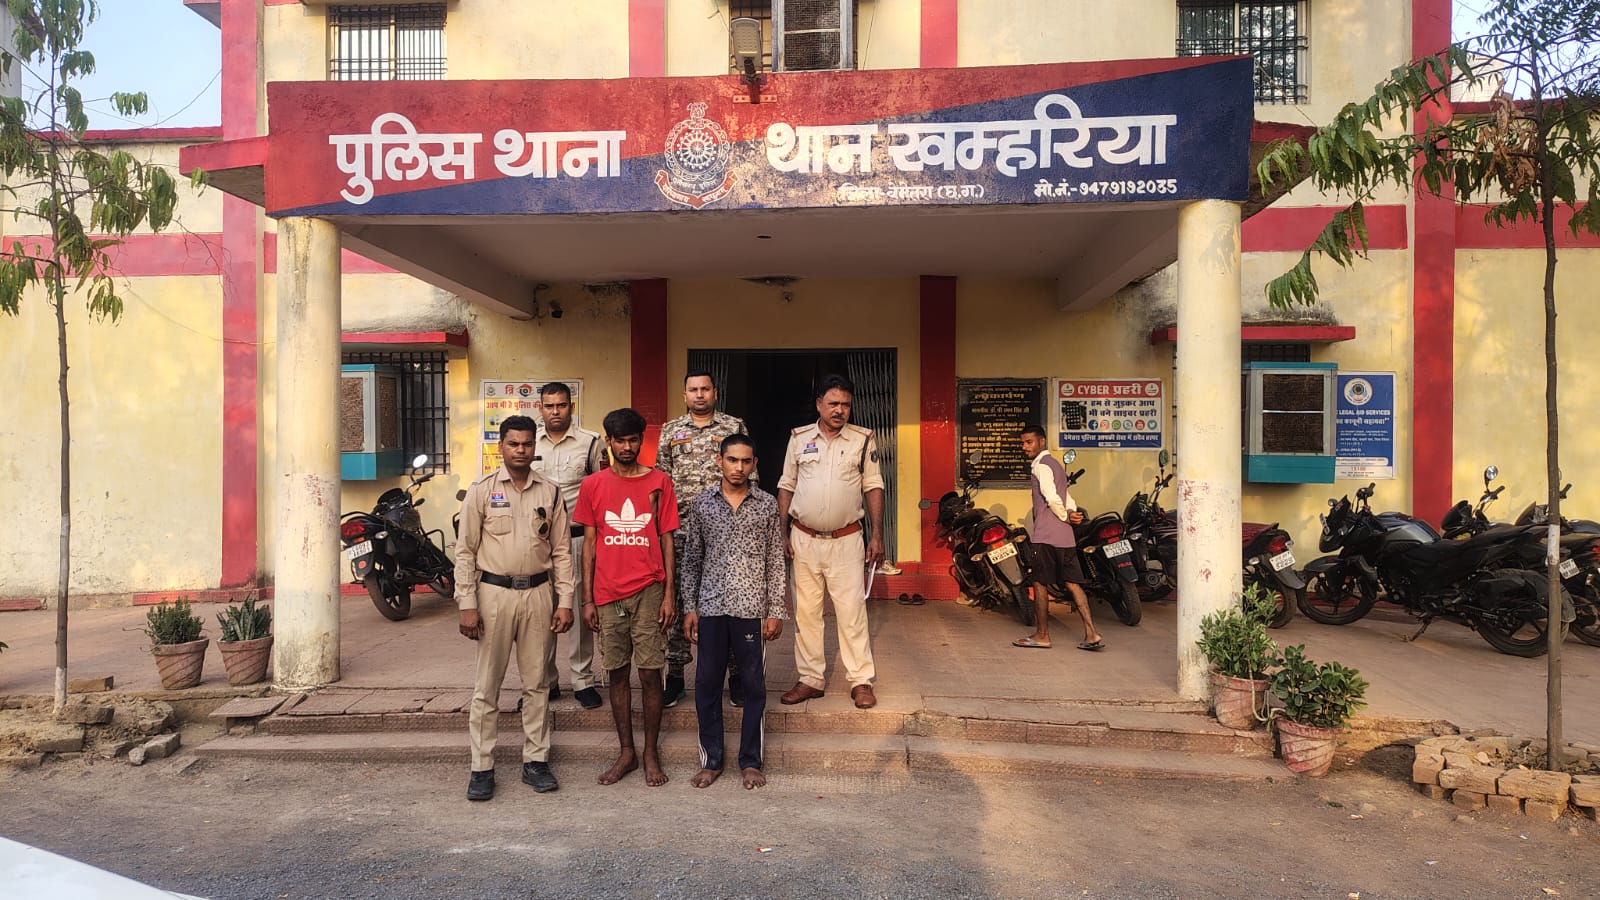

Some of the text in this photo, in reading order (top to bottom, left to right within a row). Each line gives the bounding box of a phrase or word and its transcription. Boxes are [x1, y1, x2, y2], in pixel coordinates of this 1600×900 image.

[329, 112, 627, 206] पुलिस थाना
[888, 93, 1177, 178] खम्हरिया
[1077, 383, 1142, 395] CYBER प्रहरी
[604, 533, 650, 547] adidas
